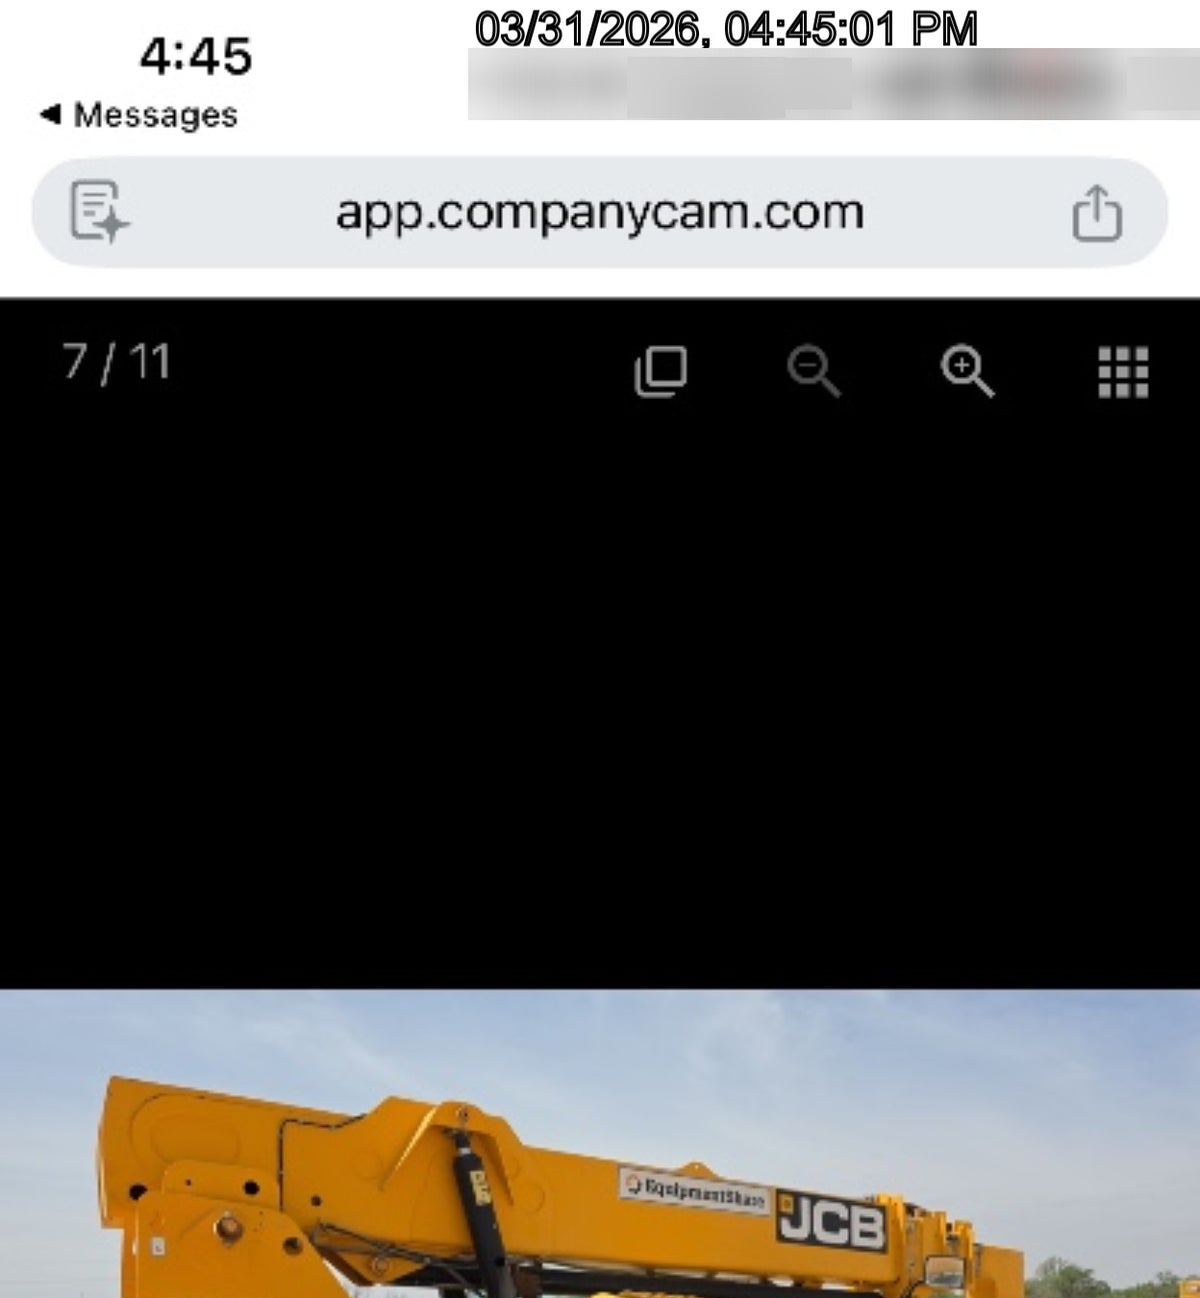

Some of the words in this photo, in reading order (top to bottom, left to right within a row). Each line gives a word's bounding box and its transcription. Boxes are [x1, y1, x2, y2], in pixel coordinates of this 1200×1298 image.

[140, 36, 252, 76] 4:45
[75, 101, 238, 134] Messages
[336, 200, 864, 240] app.companycam.com
[63, 342, 87, 379] 7
[131, 342, 168, 379] 11
[780, 1196, 886, 1250] JCB
